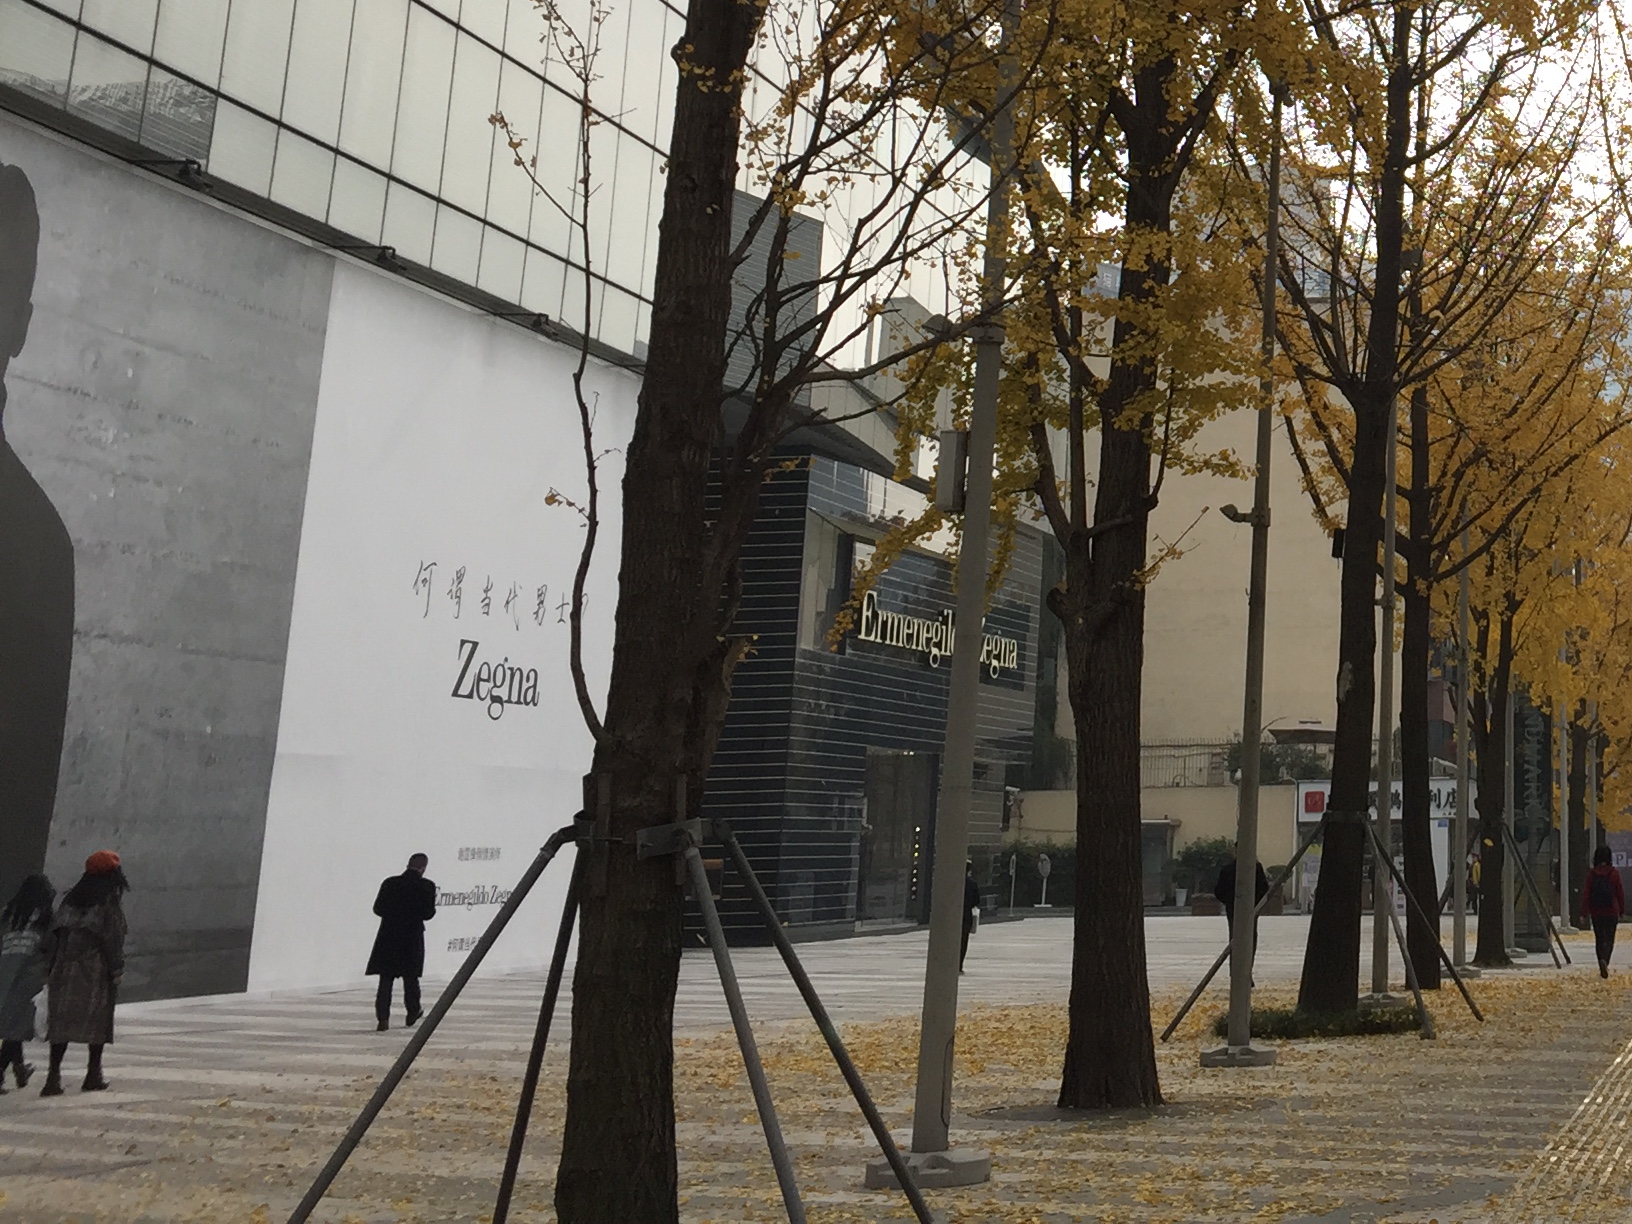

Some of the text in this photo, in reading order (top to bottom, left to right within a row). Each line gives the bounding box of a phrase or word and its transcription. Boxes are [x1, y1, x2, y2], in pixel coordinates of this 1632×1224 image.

[857, 589, 1018, 679] Ermenegil egna
[451, 638, 540, 721] Zegna
